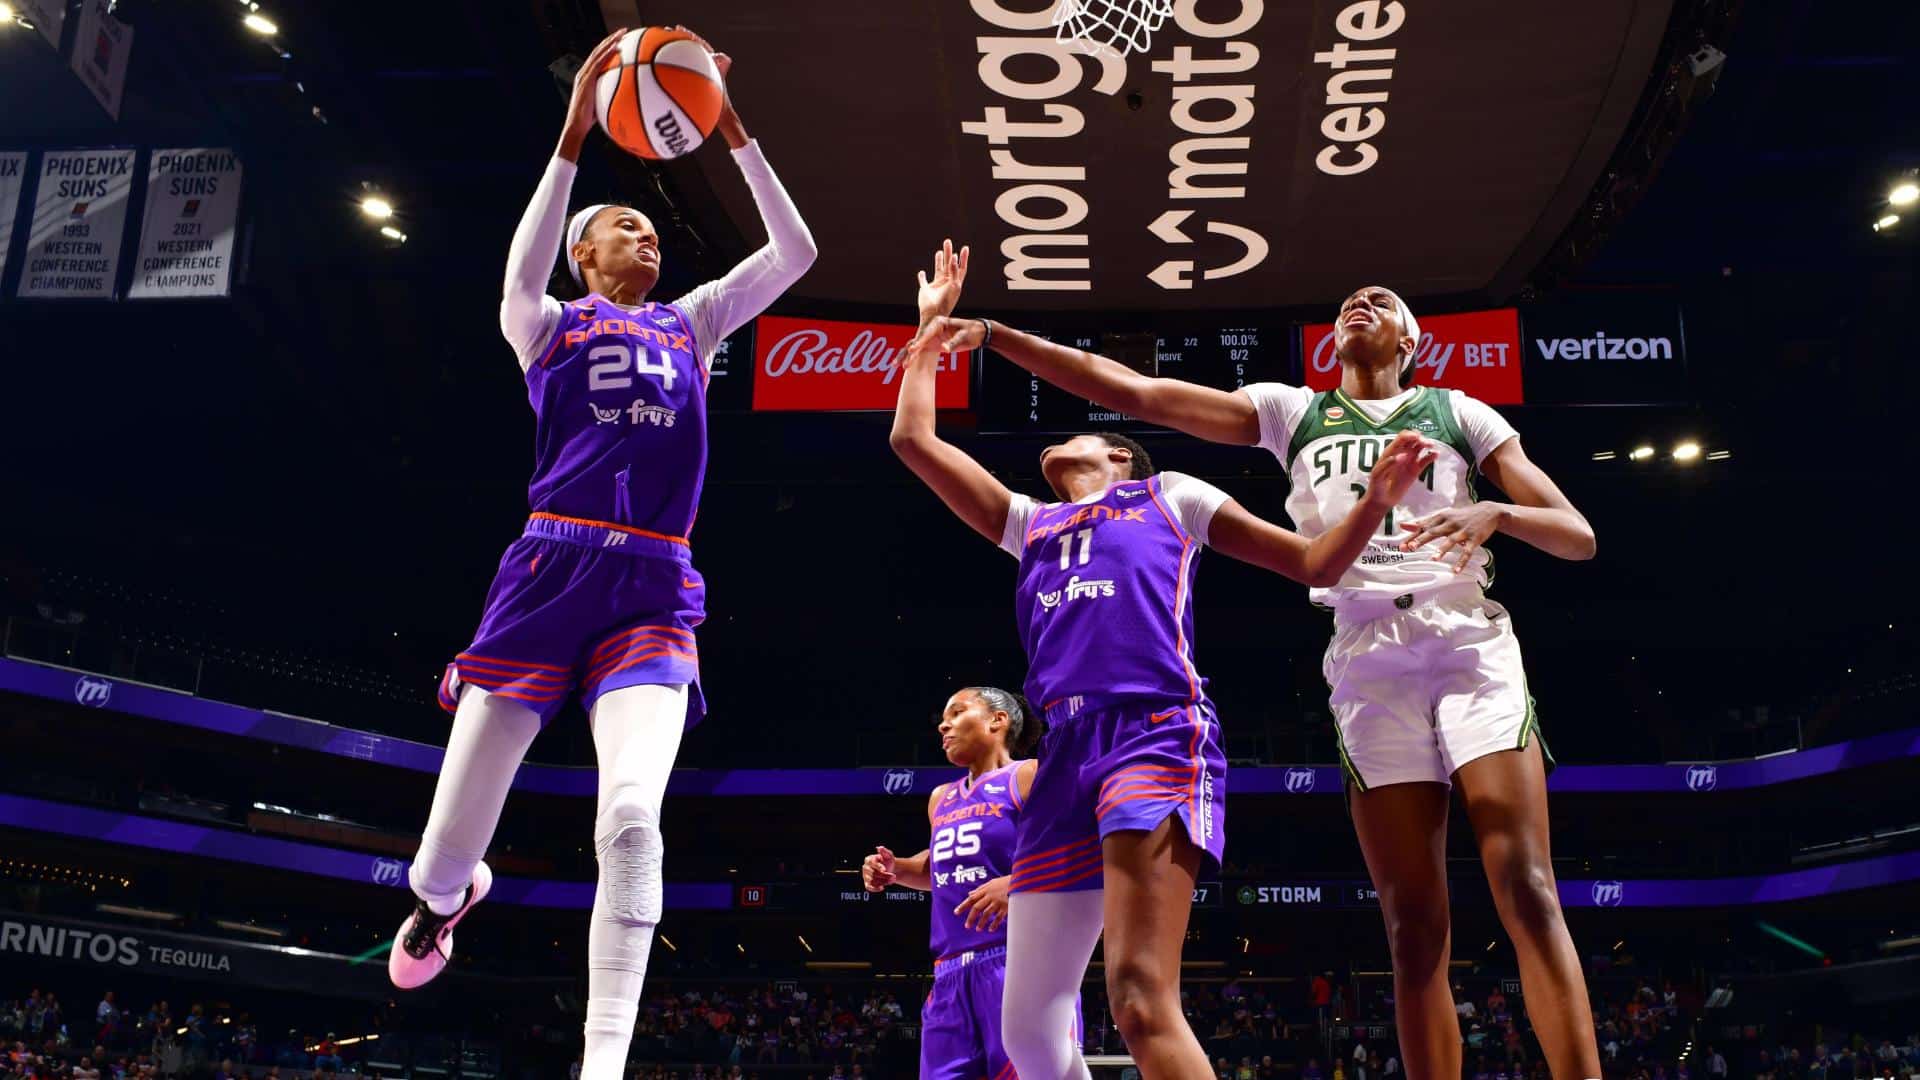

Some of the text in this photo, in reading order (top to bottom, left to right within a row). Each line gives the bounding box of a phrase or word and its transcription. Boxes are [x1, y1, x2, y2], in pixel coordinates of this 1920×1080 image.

[46, 156, 128, 176] PHOENIX
[157, 155, 238, 173] PHOENIX
[57, 179, 108, 198] SUNS
[169, 177, 218, 195] SUNS
[63, 225, 90, 237] 1993
[173, 223, 201, 235] 2021
[44, 242, 101, 255] WESTERN
[157, 239, 213, 252] WESTERN
[30, 259, 110, 273] CONFERENCE
[143, 256, 222, 270] CONFERENCE
[30, 276, 103, 290] CHAMPIONS
[145, 274, 215, 287] CHAMPIONS
[565, 319, 690, 353] PHOENIX
[1220, 335, 1258, 346] 100.0%
[1536, 332, 1672, 361] verizon
[764, 329, 899, 385] Bally
[1230, 349, 1249, 361] 8/2
[1464, 343, 1510, 367] BET
[588, 344, 677, 391] 24
[1236, 364, 1244, 375] 5
[1031, 380, 1039, 391] 5
[1031, 395, 1038, 407] 3
[625, 399, 676, 427] fry's
[1030, 410, 1038, 422] 4
[1088, 412, 1120, 421] SECOND
[1028, 505, 1148, 547] PHOENIX
[1058, 528, 1093, 571] 11
[1361, 553, 1404, 565] SWEDISH
[1065, 576, 1115, 601] fry's
[1204, 771, 1214, 839] MERCURY
[933, 802, 1005, 827] PHOENIX
[933, 822, 982, 863] 25
[747, 891, 759, 901] 10
[840, 892, 861, 900] FOULS
[886, 892, 917, 900] TIMEOUTS
[918, 892, 925, 901] 5
[1258, 887, 1321, 903] STORM
[1357, 889, 1364, 899] 5
[149, 946, 231, 971] TEQUILA
